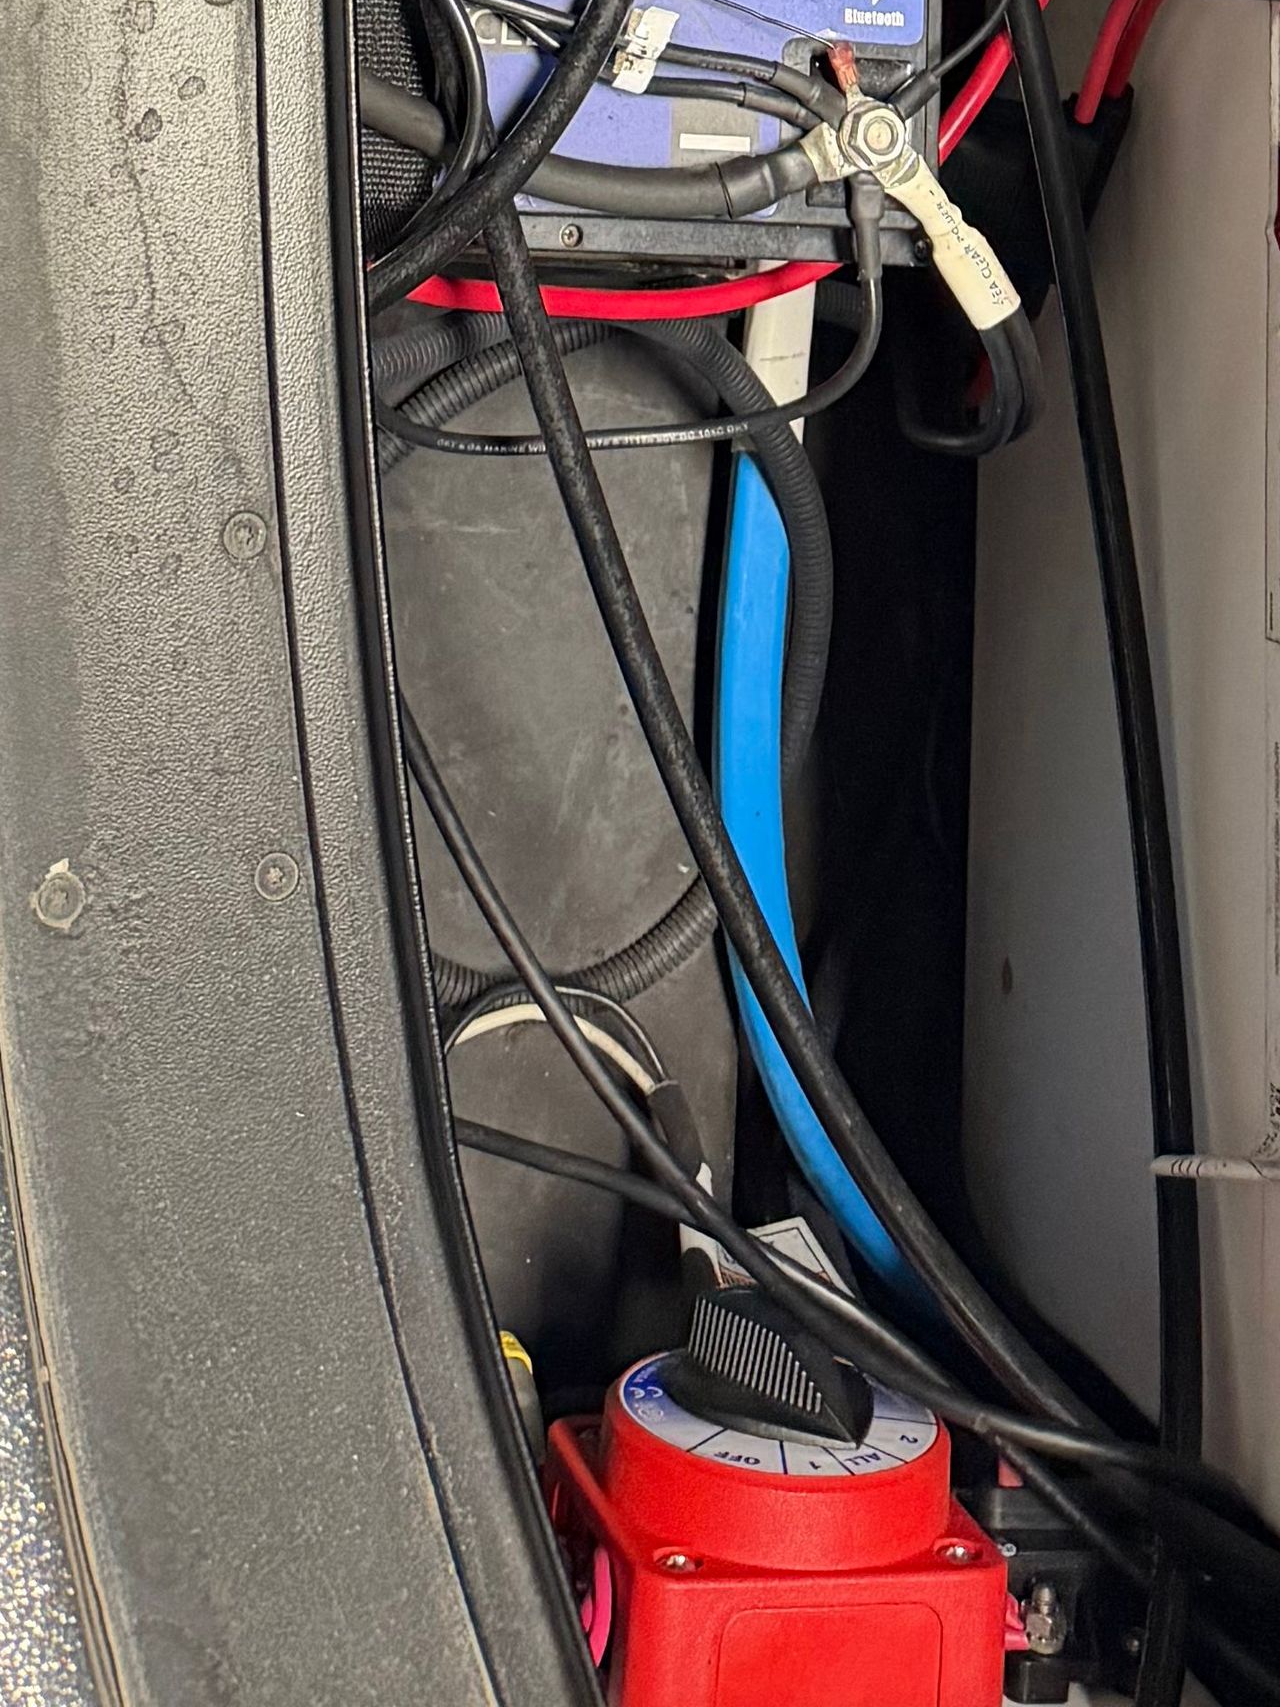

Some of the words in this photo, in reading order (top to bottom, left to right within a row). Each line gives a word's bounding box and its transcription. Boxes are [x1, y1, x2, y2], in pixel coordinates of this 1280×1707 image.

[844, 7, 905, 27] Bluetooth
[898, 1433, 919, 1446] 2
[712, 1448, 762, 1466] OFF
[808, 1459, 821, 1471] 1
[842, 1448, 882, 1468] ALL
